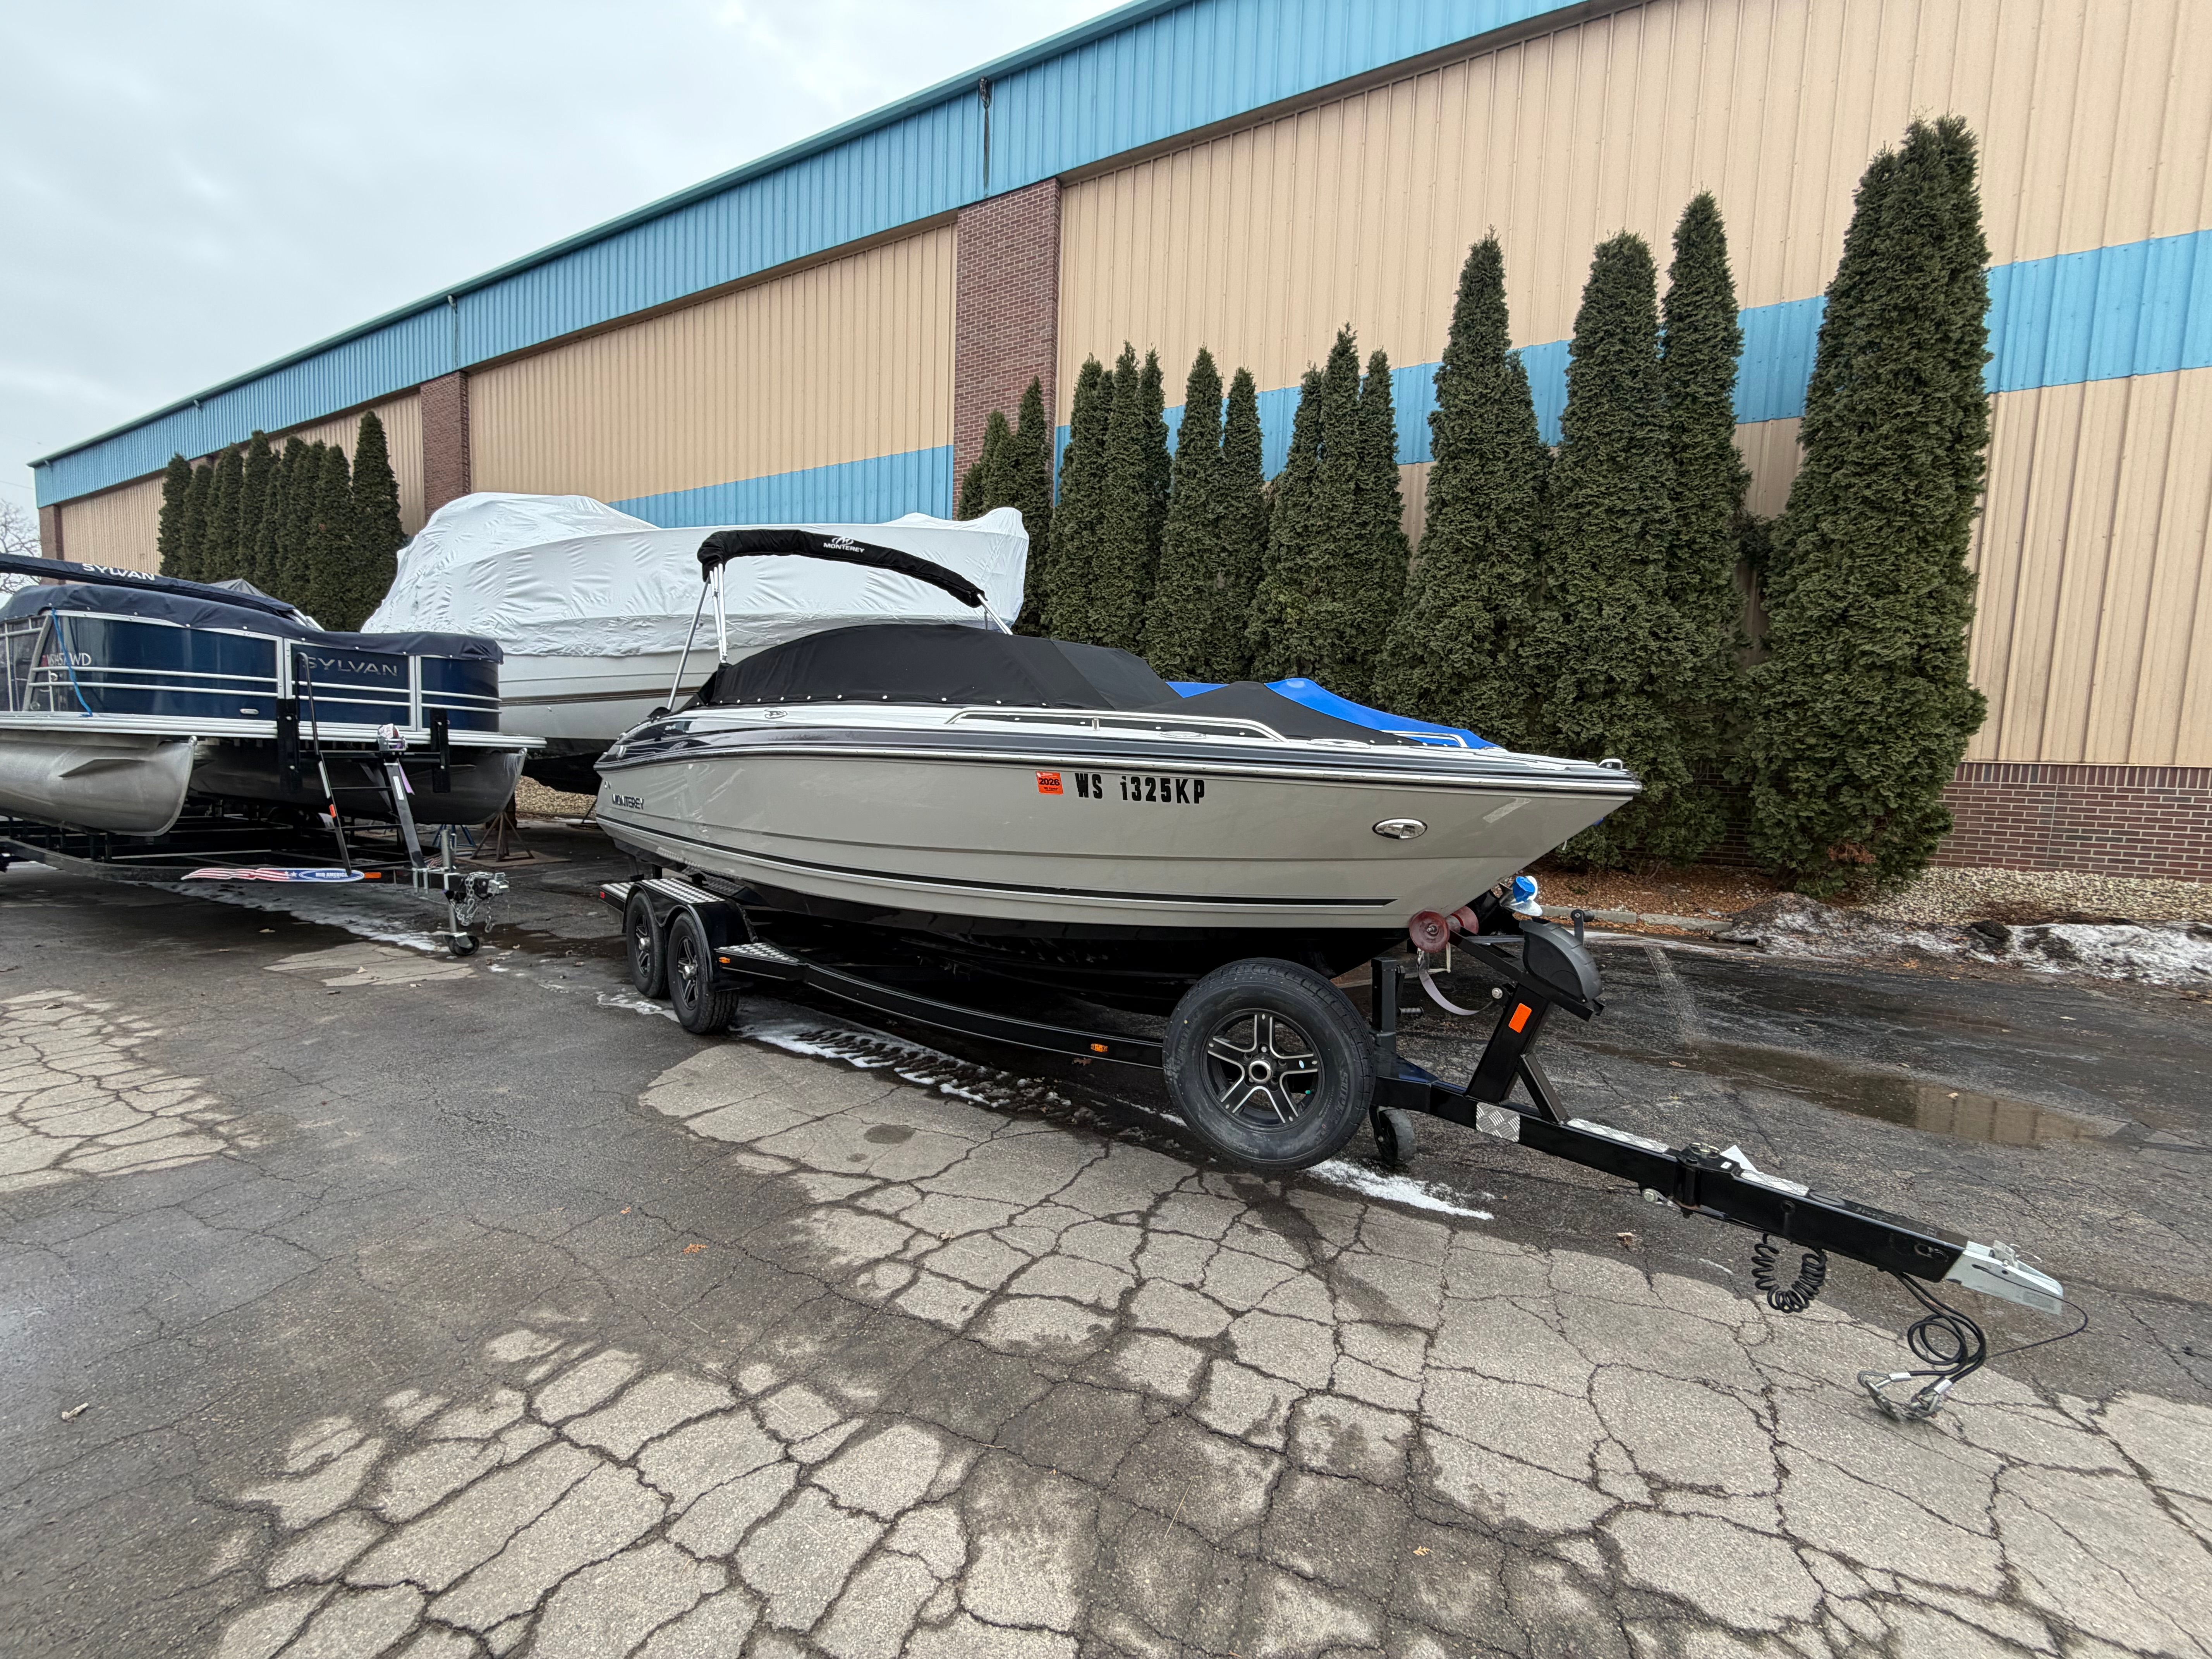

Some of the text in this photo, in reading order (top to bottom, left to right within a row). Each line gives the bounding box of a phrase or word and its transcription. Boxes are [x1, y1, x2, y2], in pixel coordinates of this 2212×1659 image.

[823, 543, 865, 553] MONTEREY
[82, 563, 155, 580] SYLVAN
[302, 657, 397, 676] SYLVAN
[1039, 777, 1060, 786] 2026
[1075, 773, 1205, 804] WS 1325KP
[612, 793, 644, 810] MONTEREY
